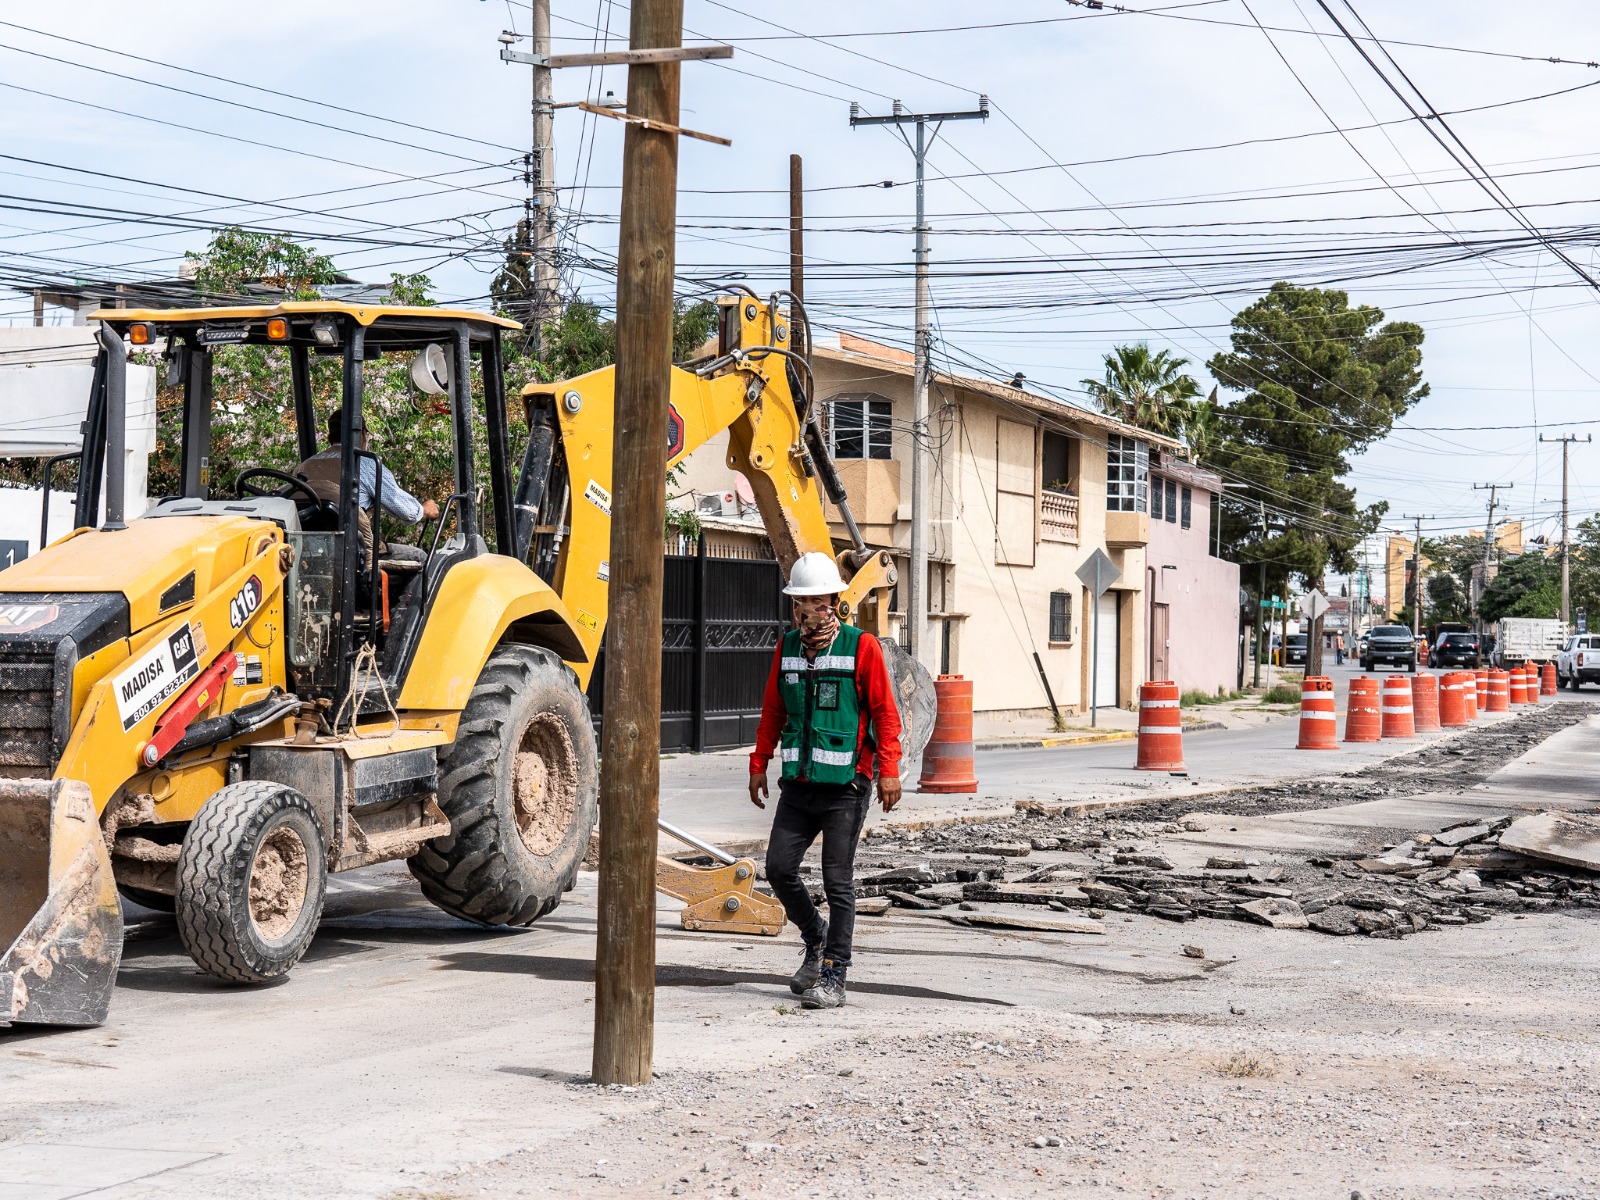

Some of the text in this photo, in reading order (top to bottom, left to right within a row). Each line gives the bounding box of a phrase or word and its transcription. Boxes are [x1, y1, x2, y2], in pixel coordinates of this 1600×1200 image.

[0, 606, 47, 625] AT
[230, 582, 257, 627] 416
[173, 633, 191, 660] CAT
[121, 658, 164, 703] MADISA
[133, 670, 189, 722] 800 92 62347
